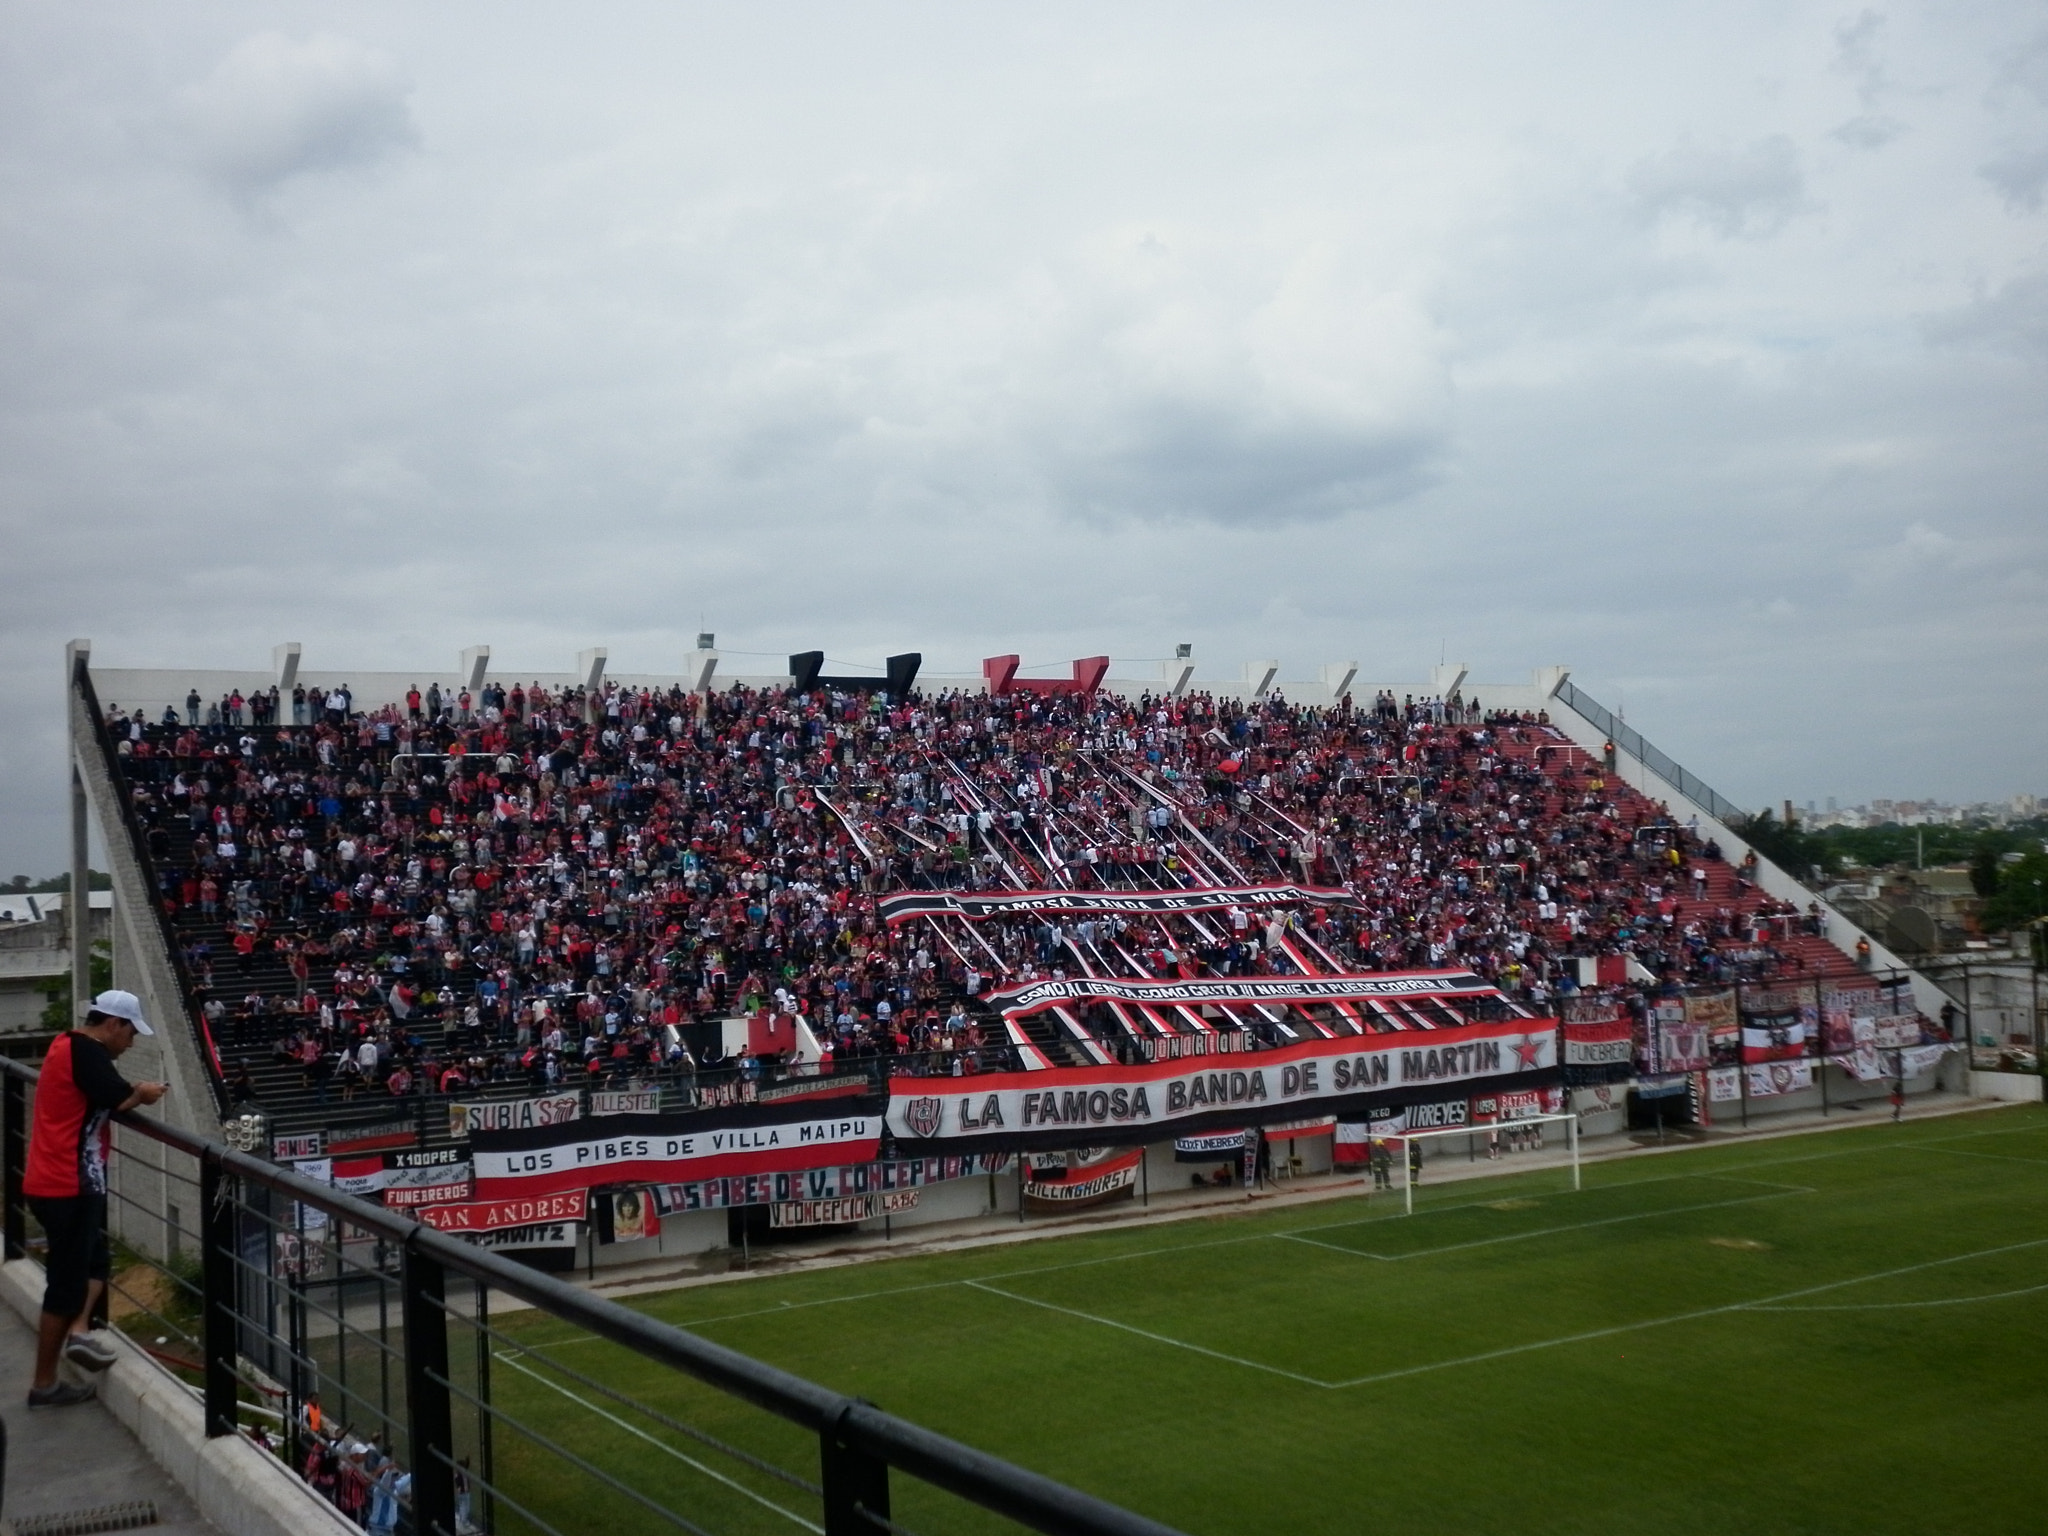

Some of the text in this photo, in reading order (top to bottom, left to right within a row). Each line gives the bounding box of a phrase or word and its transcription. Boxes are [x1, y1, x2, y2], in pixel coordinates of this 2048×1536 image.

[1085, 897, 1151, 911] BANDA
[1162, 897, 1191, 909] DE
[1202, 892, 1241, 905] SAN
[1191, 984, 1237, 997] GRITA
[1255, 983, 1303, 996] NADIE
[1303, 982, 1326, 996] LA
[1327, 980, 1377, 994] PUEDE
[1379, 979, 1440, 993] CORRER
[1569, 1040, 1632, 1061] FUNEBRERO
[959, 1040, 1501, 1131] LA FAMOSA BANDA DE SAN MARTIN
[1502, 1092, 1539, 1108] BATALLA
[1405, 1101, 1466, 1129] VIRREYES
[1515, 1108, 1525, 1117] DE
[507, 1121, 865, 1173] LOS PIBES DE VILLA MAIPU
[395, 1154, 405, 1167] X
[653, 1154, 976, 1216] LOS PIBES DE V. CONCEPCION
[1026, 1168, 1131, 1199] BILLINGHURST
[387, 1184, 469, 1204] FUNEBREROS
[882, 1195, 899, 1210] LA
[423, 1196, 581, 1228] SAN ANDRES
